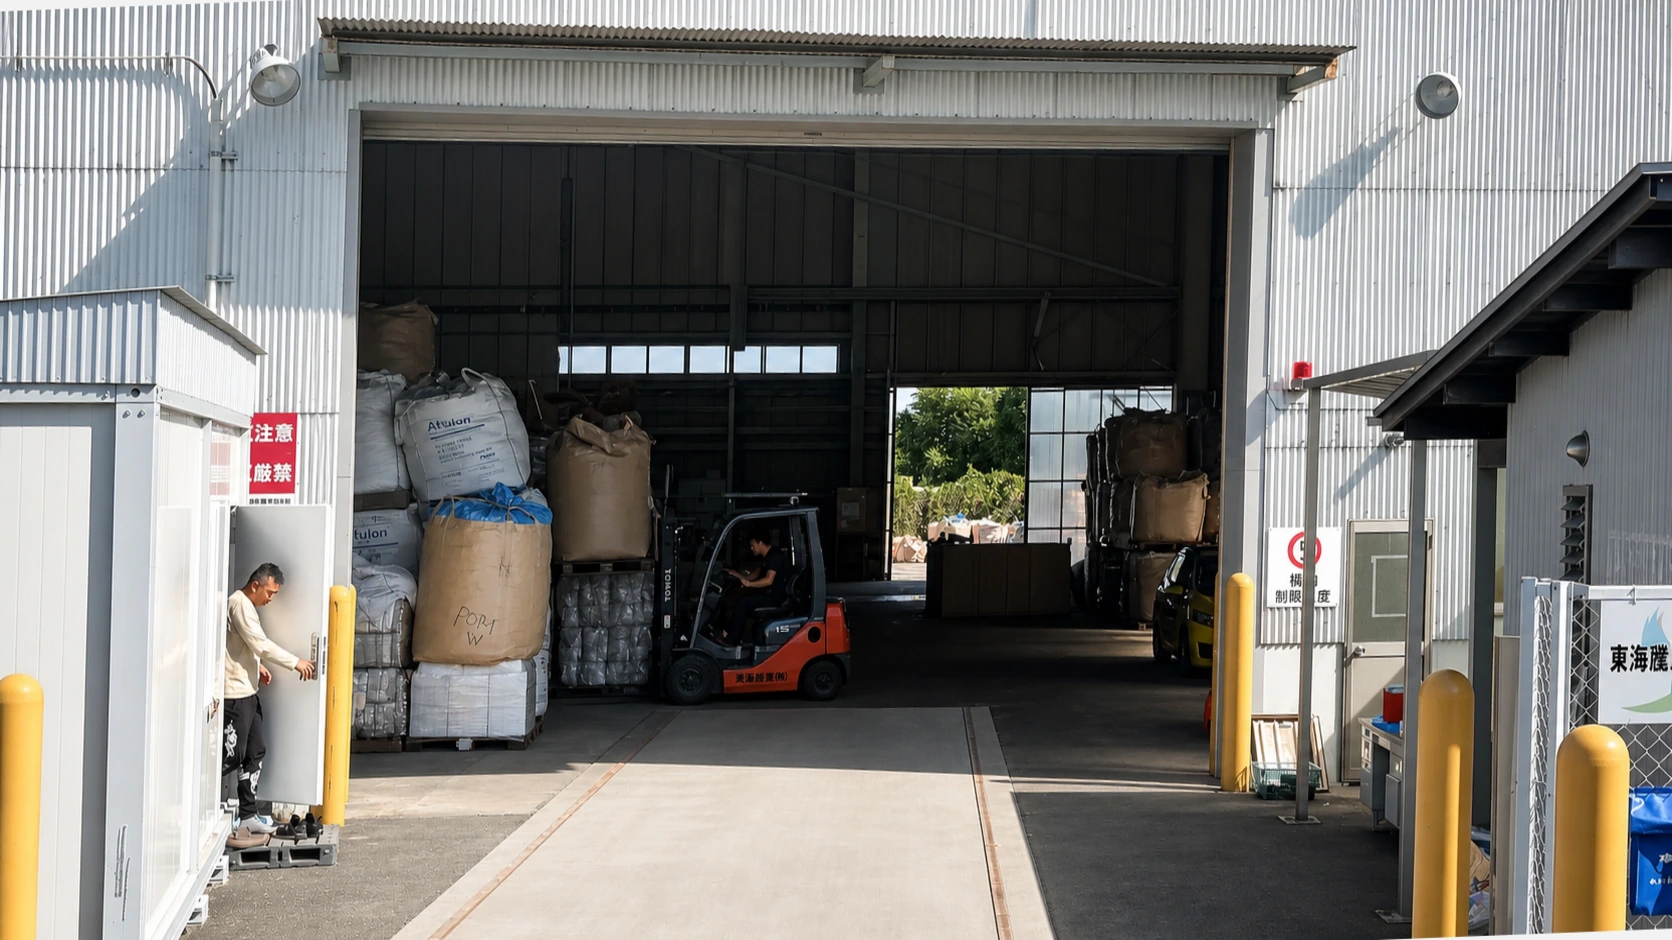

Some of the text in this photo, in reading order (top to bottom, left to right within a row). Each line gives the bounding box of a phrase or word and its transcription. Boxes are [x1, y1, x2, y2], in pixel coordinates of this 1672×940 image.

[249, 462, 292, 483] 厳禁
[354, 528, 388, 540] tulon
[1275, 589, 1331, 604] 制限度
